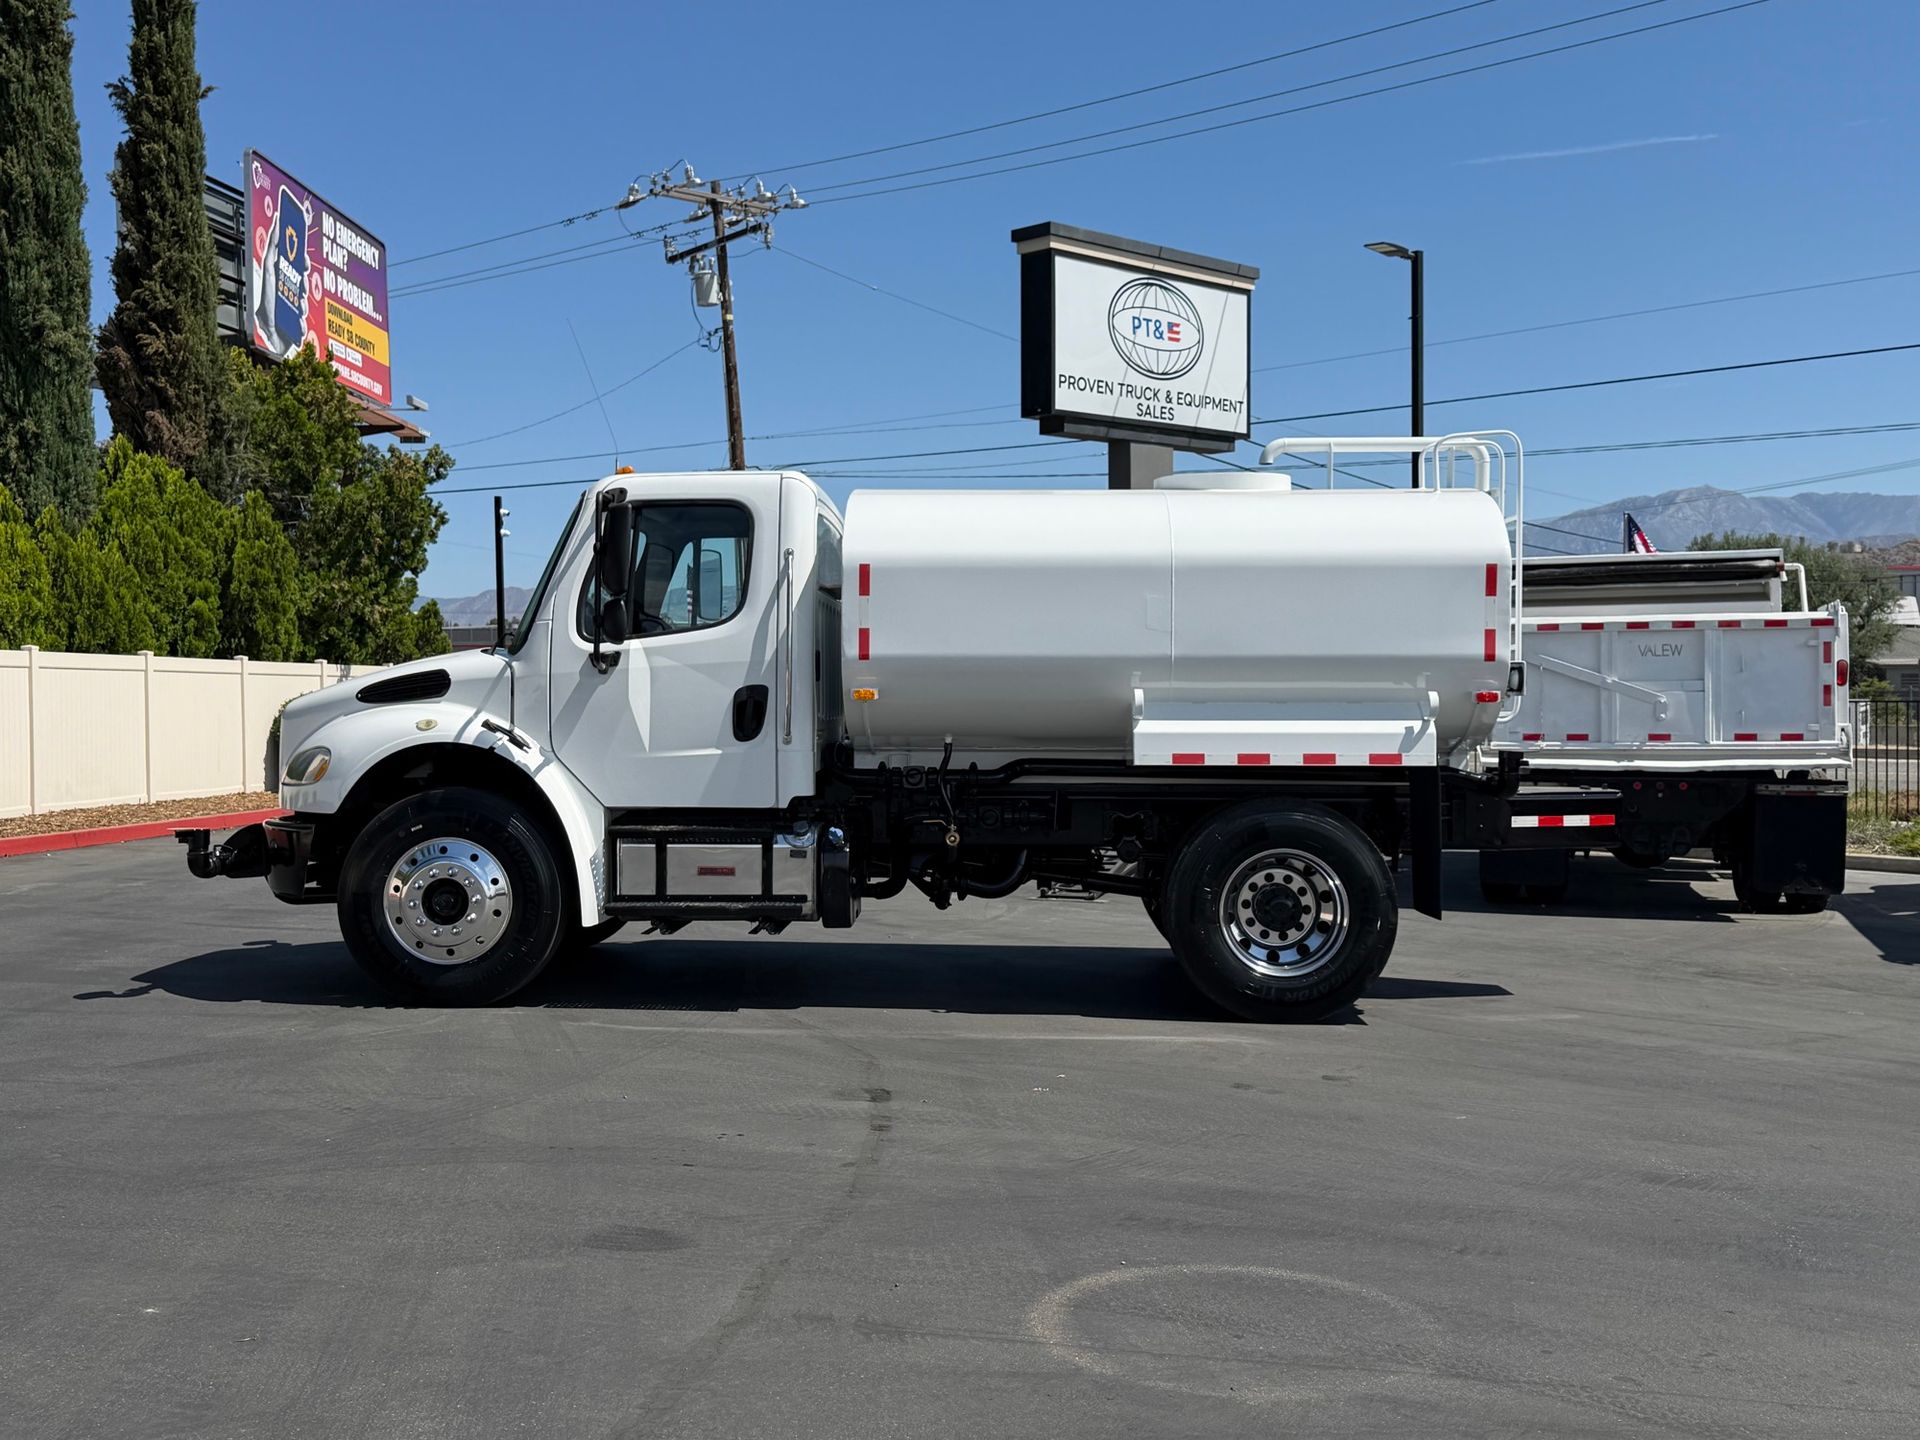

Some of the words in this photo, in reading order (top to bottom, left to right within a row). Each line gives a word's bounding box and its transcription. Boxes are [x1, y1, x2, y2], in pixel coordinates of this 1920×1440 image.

[322, 211, 335, 239] NO
[336, 221, 379, 271] EMERGENCY
[322, 236, 348, 272] PLAN?
[279, 255, 302, 287] READY
[323, 266, 336, 294] NO
[327, 301, 353, 326] DOWNLOAD
[328, 318, 346, 339] READY
[355, 333, 375, 356] COUNTY
[1058, 374, 1114, 396] PROVEN
[1118, 383, 1161, 403] TRUCK
[1165, 390, 1173, 404] &
[1177, 392, 1244, 414] EQUIPMENT
[1136, 403, 1175, 421] SALES
[1638, 643, 1683, 657] VALEW
